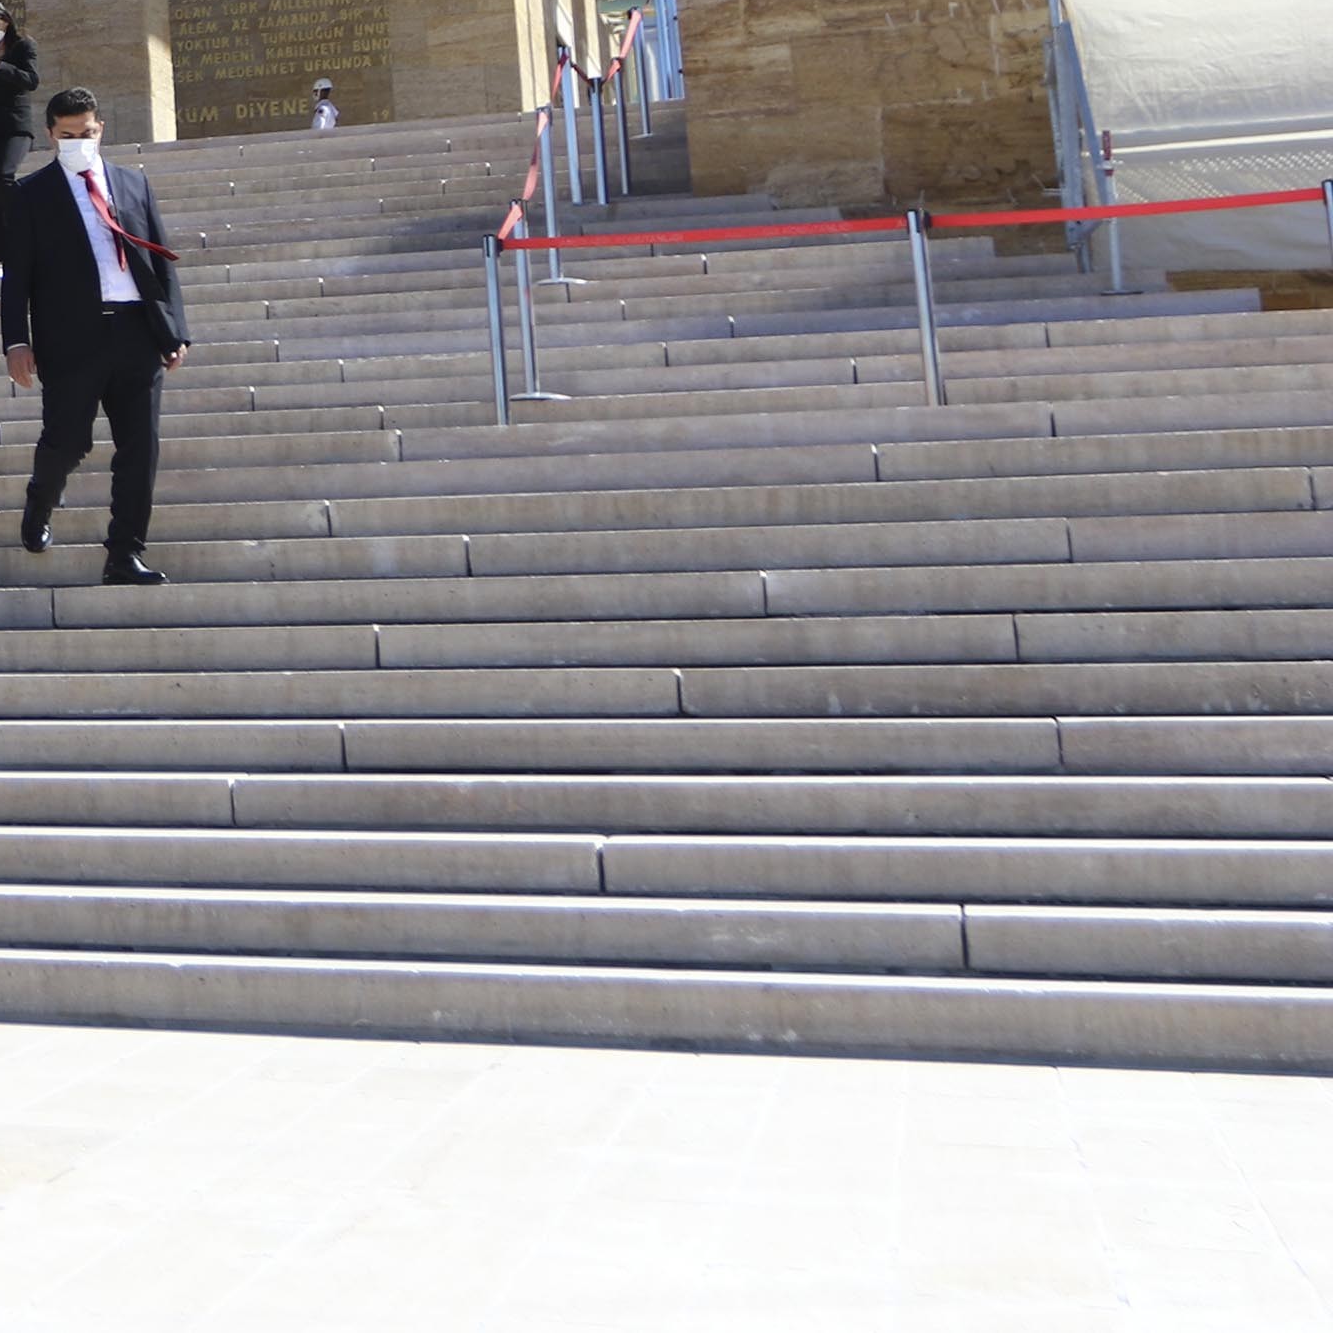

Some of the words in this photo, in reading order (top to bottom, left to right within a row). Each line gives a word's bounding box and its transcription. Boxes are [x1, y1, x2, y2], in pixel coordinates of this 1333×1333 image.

[174, 6, 212, 20] OLAN
[230, 18, 251, 32] AZ
[258, 11, 328, 29] ZAMANDA
[176, 36, 230, 53] YOKTUR
[304, 56, 372, 73] UFKUNDA
